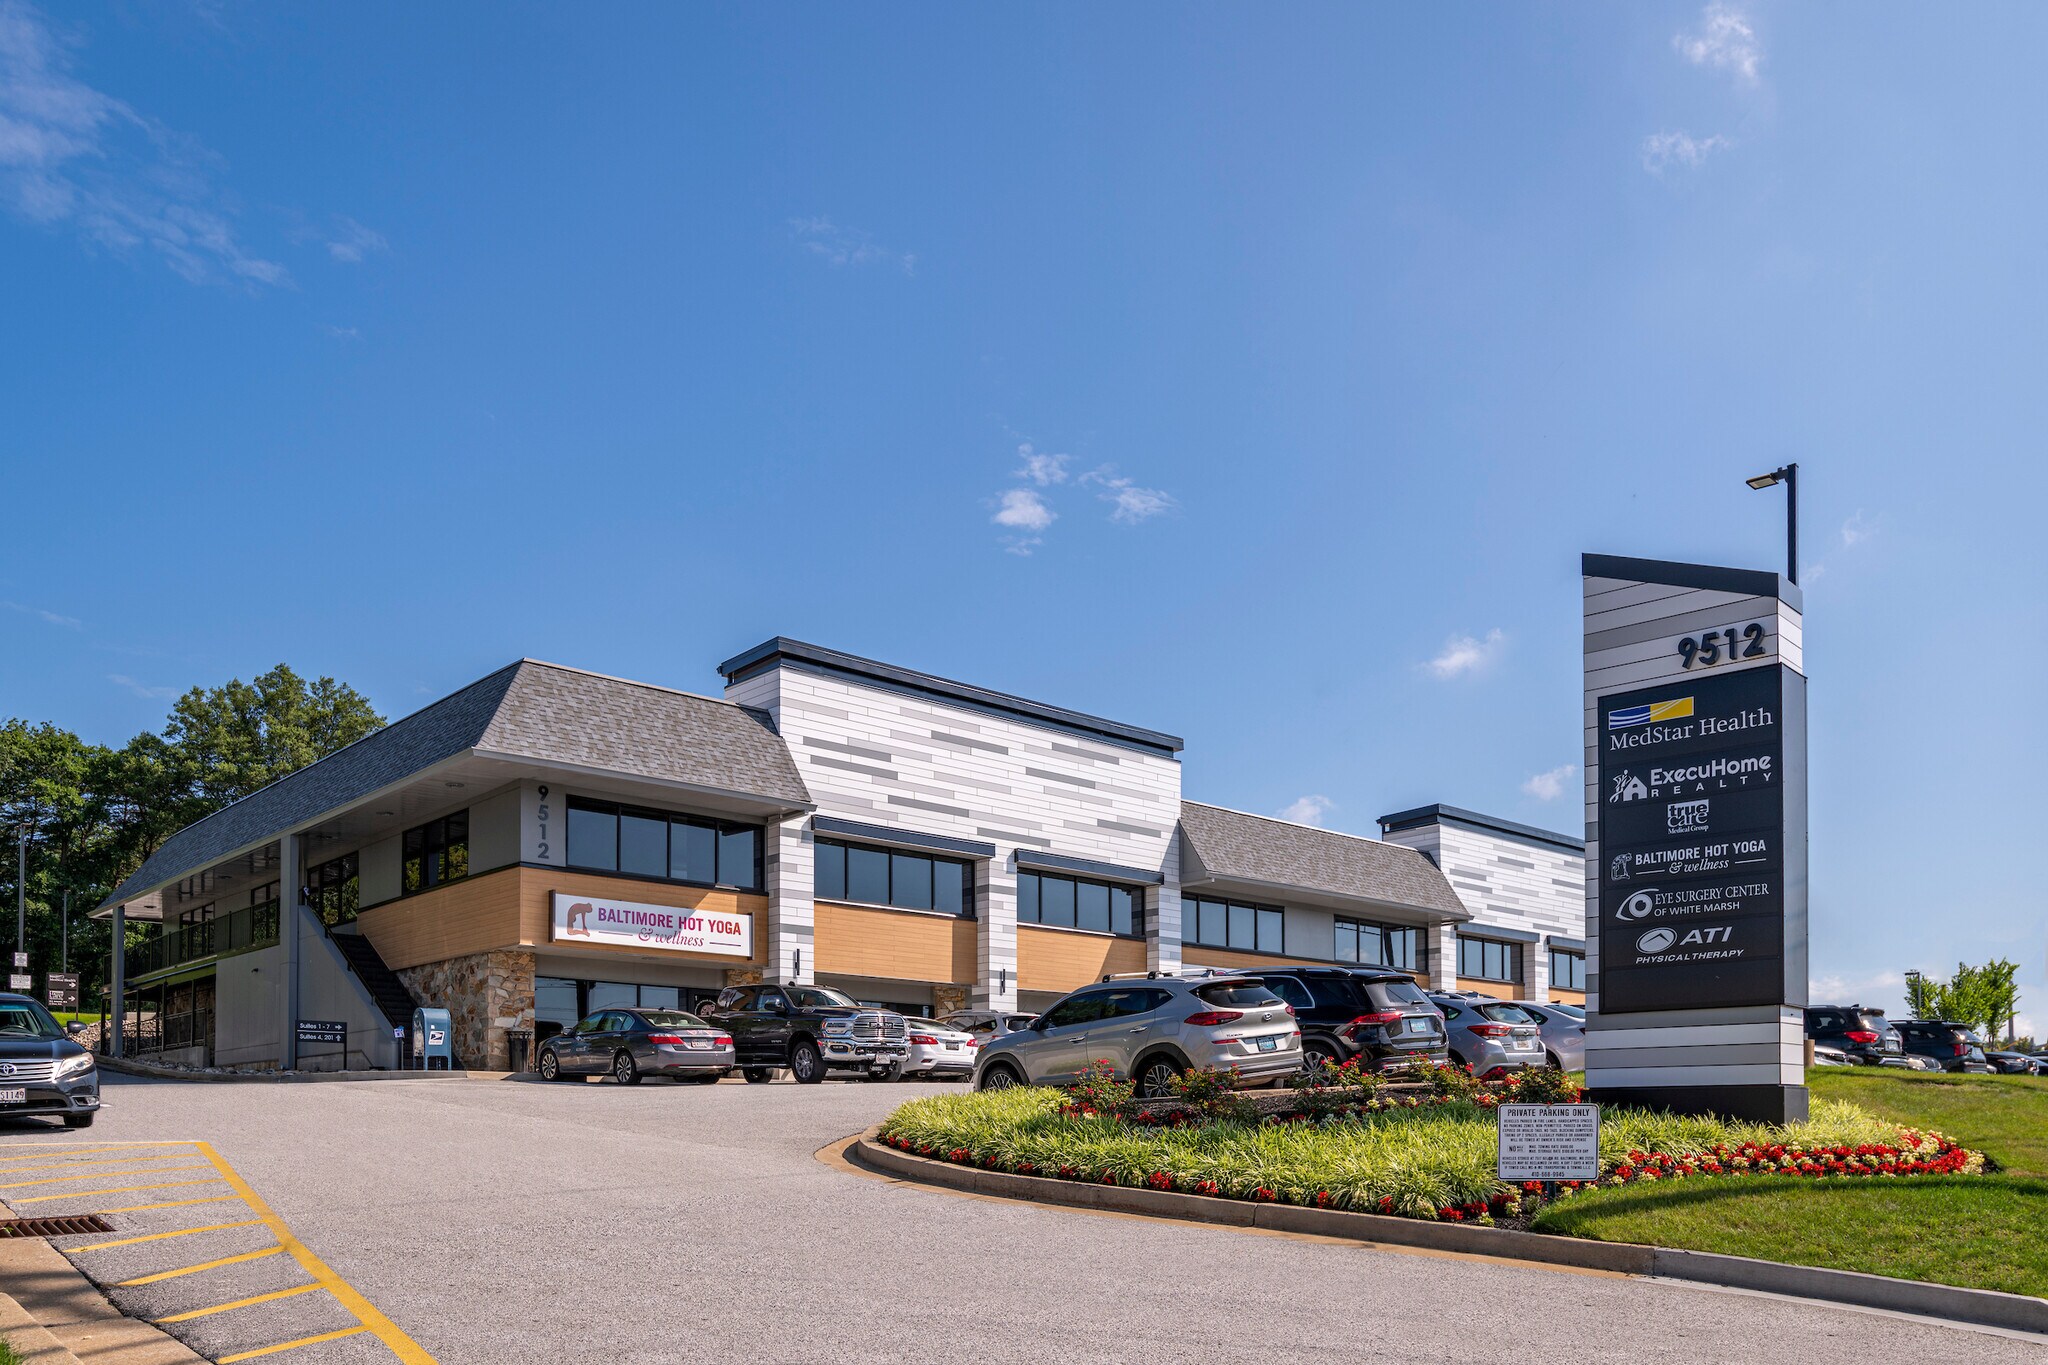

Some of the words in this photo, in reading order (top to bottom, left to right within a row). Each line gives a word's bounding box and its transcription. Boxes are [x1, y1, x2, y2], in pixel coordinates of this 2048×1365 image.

[1678, 623, 1766, 669] 9512
[1610, 725, 1694, 751] MedStar
[1699, 707, 1774, 736] Health
[1650, 755, 1772, 786] ExecuHome
[1651, 773, 1772, 797] REALTY
[1667, 811, 1708, 828] care
[1669, 803, 1708, 818] true
[1668, 826, 1690, 834] Medical
[1635, 847, 1700, 866] BALTIMORE
[1704, 844, 1729, 857] HOT
[1732, 839, 1767, 854] YOGA
[1669, 862, 1683, 874] &
[1683, 858, 1730, 873] wellness
[1655, 892, 1674, 905] EYE
[1675, 888, 1723, 903] SURGERY
[1725, 883, 1770, 898] CENTER
[1654, 908, 1667, 917] OF
[1669, 904, 1701, 915] WHITE
[1703, 901, 1740, 912] MARSH
[598, 907, 674, 929] BALTIMORE
[678, 916, 704, 932] HOT
[708, 919, 742, 936] YOGA
[638, 927, 654, 941] &
[655, 930, 705, 947] wellness
[1679, 926, 1733, 946] ATI
[1635, 953, 1691, 964] PHYSICAL
[1692, 949, 1745, 960] THERAPY
[1508, 1108, 1536, 1116] PRIVATE
[1540, 1108, 1570, 1116] PARKING
[1572, 1108, 1590, 1116] ONLY
